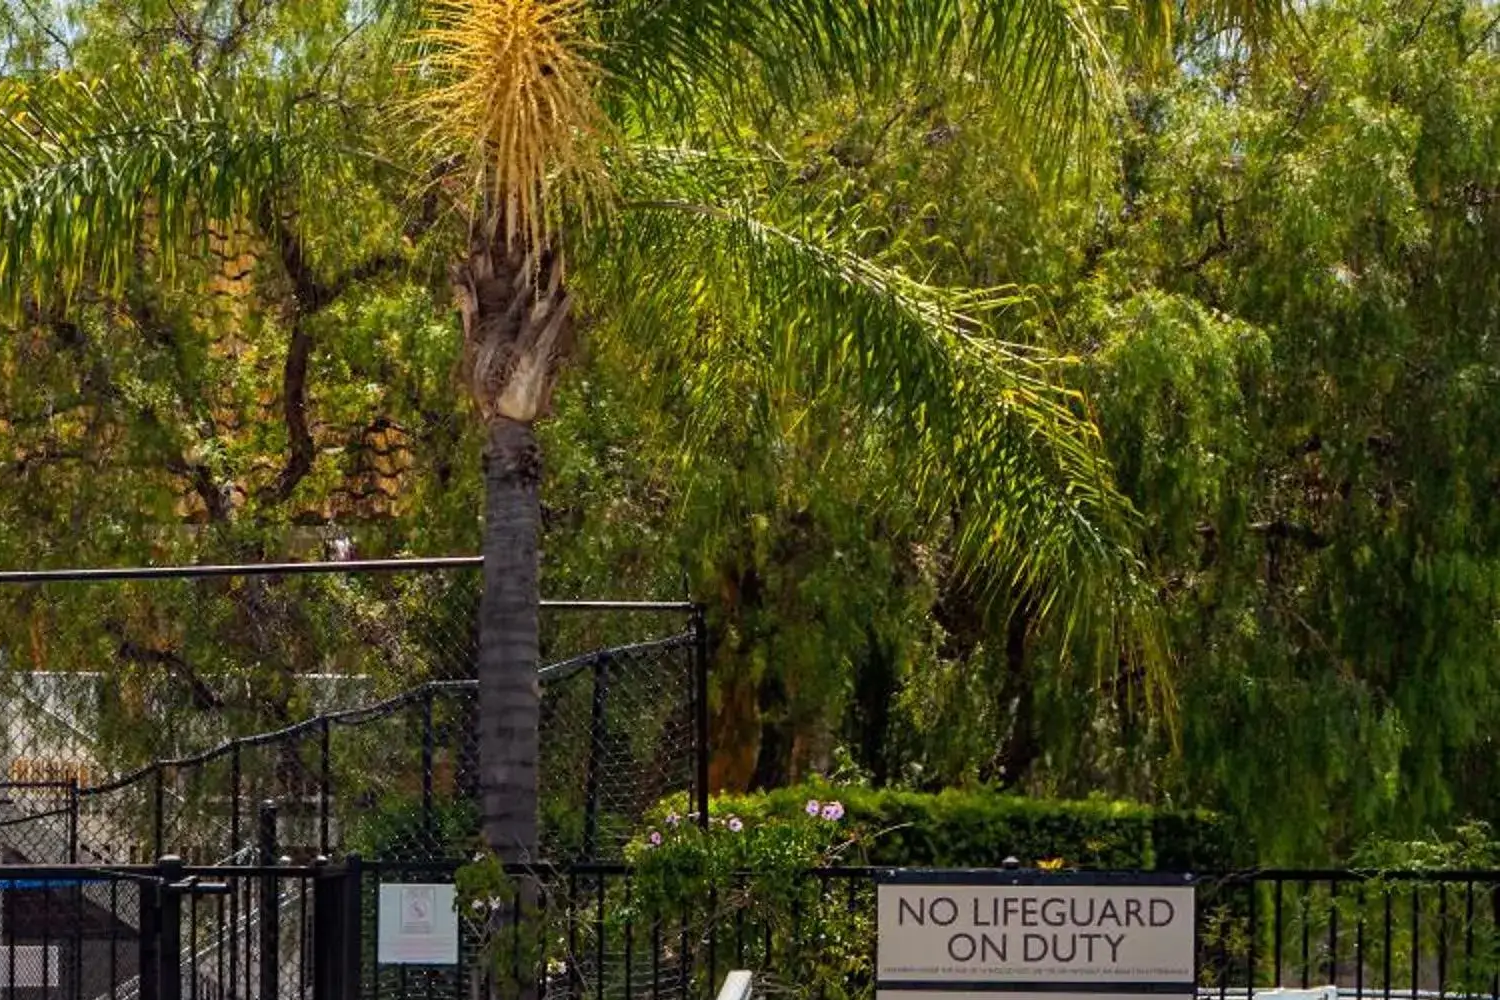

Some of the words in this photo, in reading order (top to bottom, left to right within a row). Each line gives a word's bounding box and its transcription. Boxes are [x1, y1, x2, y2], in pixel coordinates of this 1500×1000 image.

[898, 897, 959, 927] NO
[973, 897, 1175, 927] LIFEGUARD
[947, 933, 1007, 962] ON
[1023, 933, 1125, 963] DUTY
